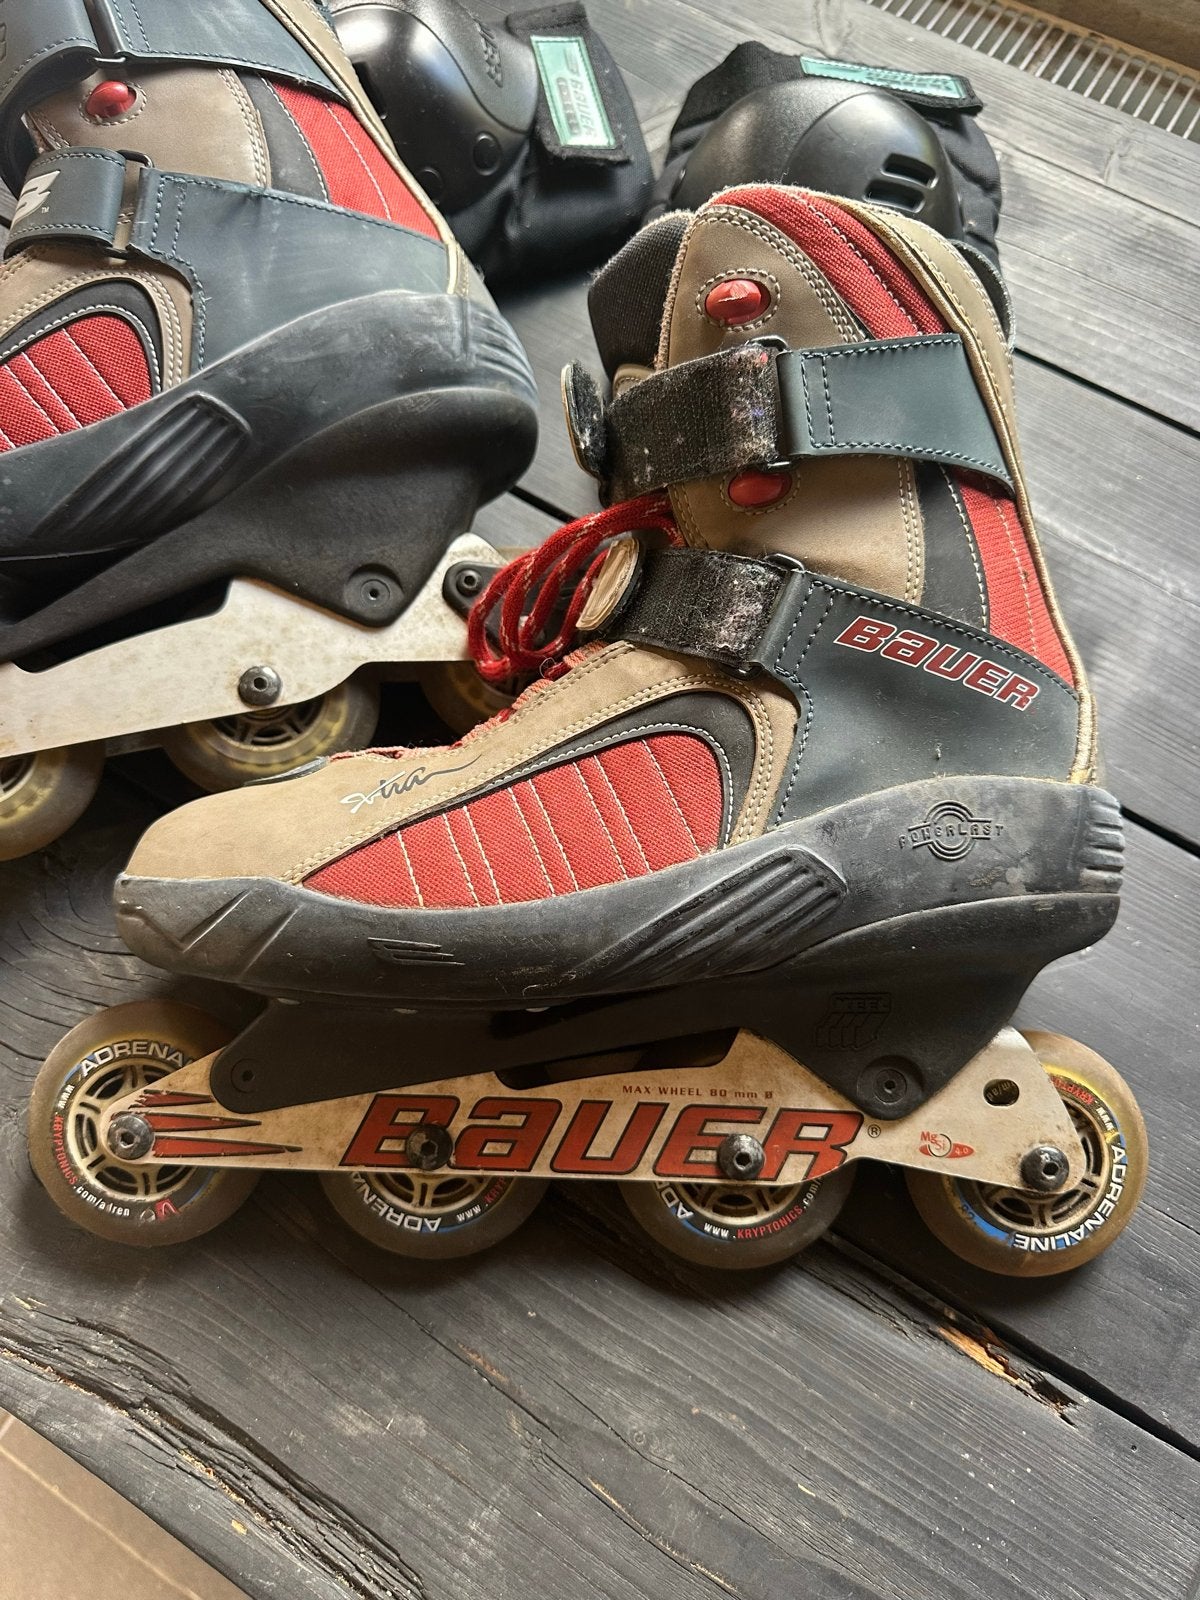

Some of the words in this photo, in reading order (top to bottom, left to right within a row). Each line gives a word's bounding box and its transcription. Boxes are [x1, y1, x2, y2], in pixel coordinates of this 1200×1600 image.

[899, 822, 1004, 849] POWERLAST
[80, 1040, 196, 1078] ADRENA
[622, 1084, 651, 1095] MAX
[658, 1086, 702, 1097] WHEEL
[710, 1088, 727, 1098] 80
[734, 1090, 757, 1099] mm
[1013, 1145, 1128, 1252] ADRENALINE
